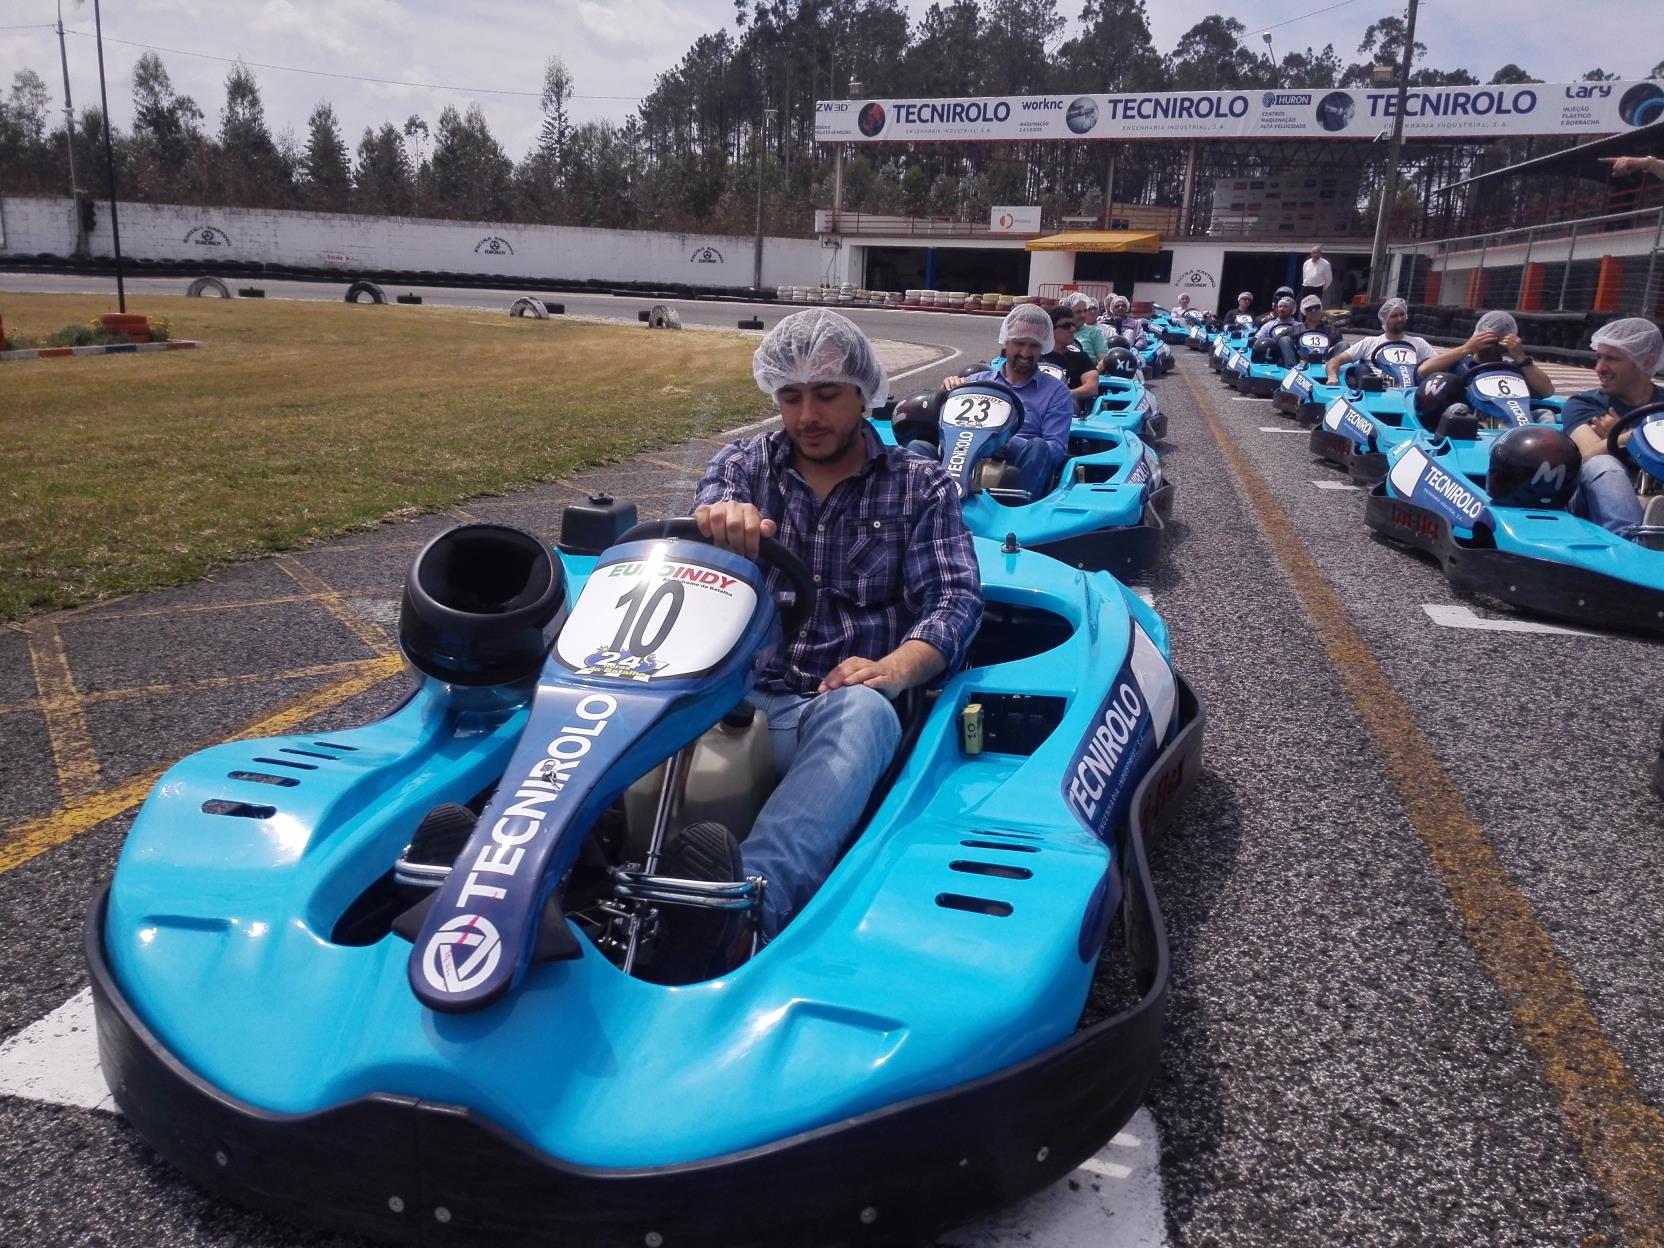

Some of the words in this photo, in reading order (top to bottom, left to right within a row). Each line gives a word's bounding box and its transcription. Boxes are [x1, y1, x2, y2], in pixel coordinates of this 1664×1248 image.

[1108, 95, 1249, 120] TECNIROLO
[1279, 95, 1309, 104] HURON
[1366, 90, 1537, 117] TECNIROLO
[893, 101, 1011, 124] TECNIROLO
[1310, 336, 1321, 346] 13
[1116, 358, 1135, 371] XL
[1393, 349, 1408, 362] 17
[1497, 379, 1511, 395] 6
[954, 398, 991, 423] 23
[1530, 461, 1567, 490] M
[1424, 465, 1482, 519] TECNIROLO
[613, 577, 685, 658] 10
[456, 693, 618, 909] TECNIROLO
